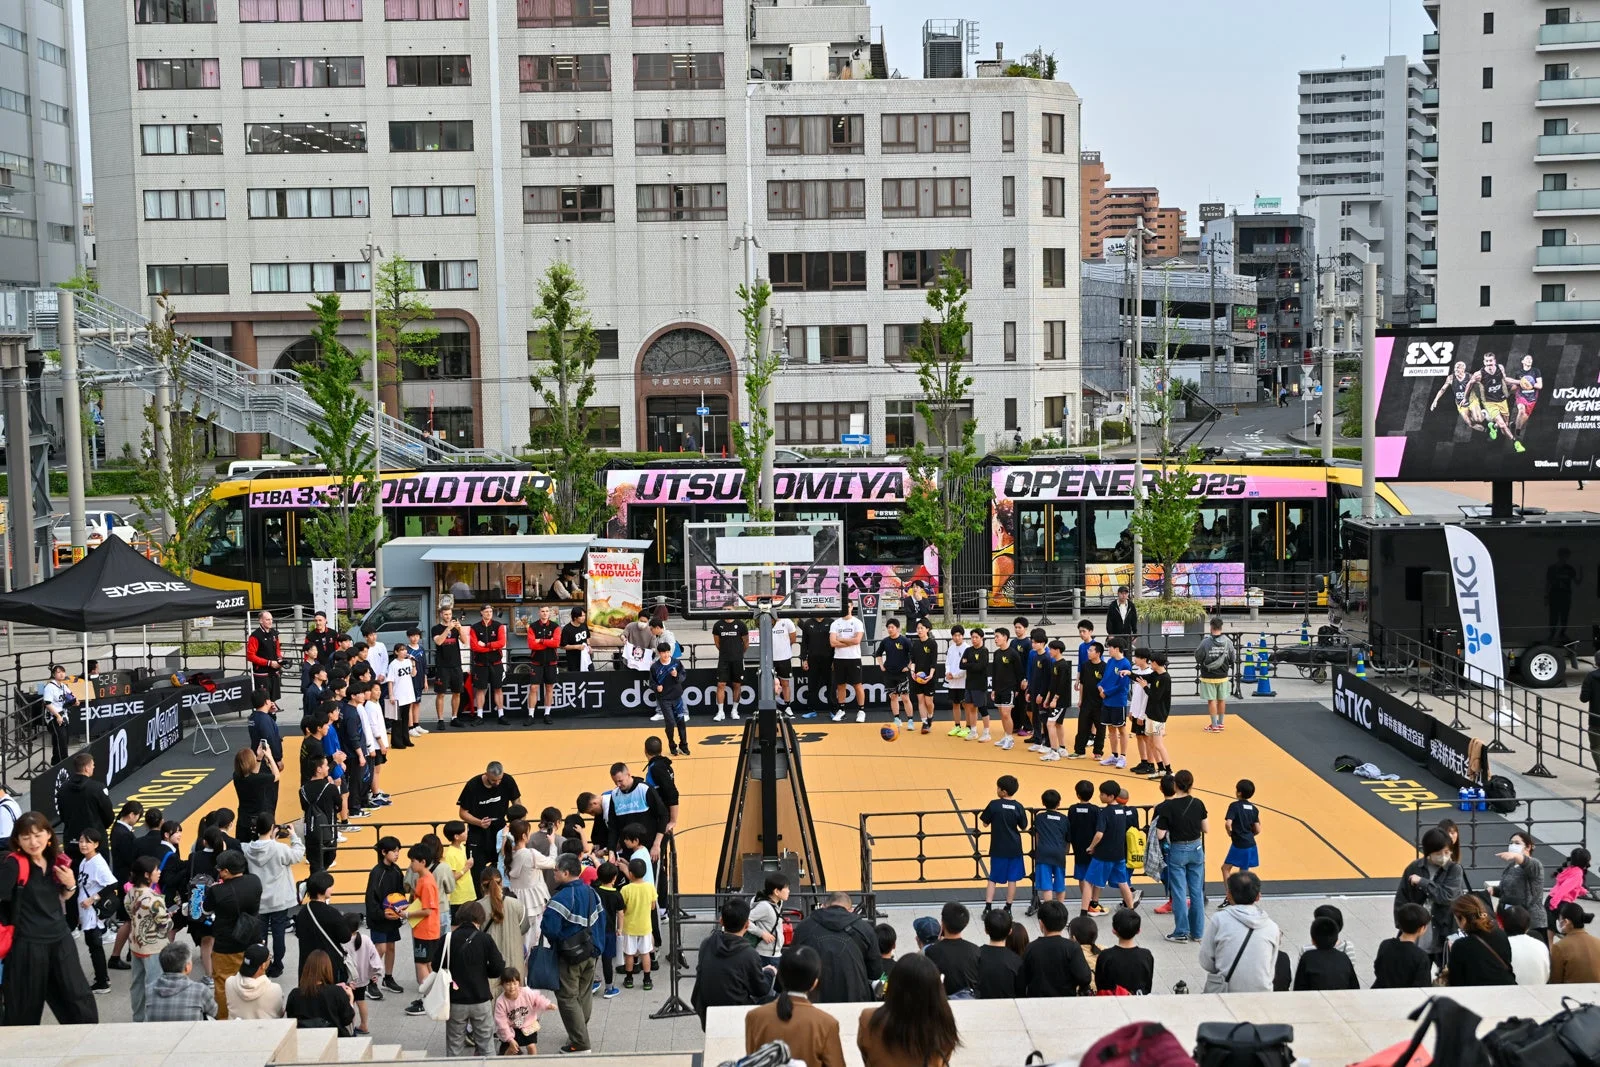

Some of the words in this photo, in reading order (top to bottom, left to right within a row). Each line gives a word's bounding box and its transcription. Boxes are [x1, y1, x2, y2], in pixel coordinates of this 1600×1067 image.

[1552, 386, 1600, 399] UTSUNO
[251, 490, 294, 505] FIBA
[635, 471, 905, 500] UTSUOMIYA
[1170, 473, 1248, 496] 025
[593, 563, 638, 571] TORTILLA
[1452, 555, 1482, 623] TKC
[620, 680, 756, 708] doomo
[1345, 688, 1372, 730] TKC
[1360, 779, 1454, 812] FIBA
